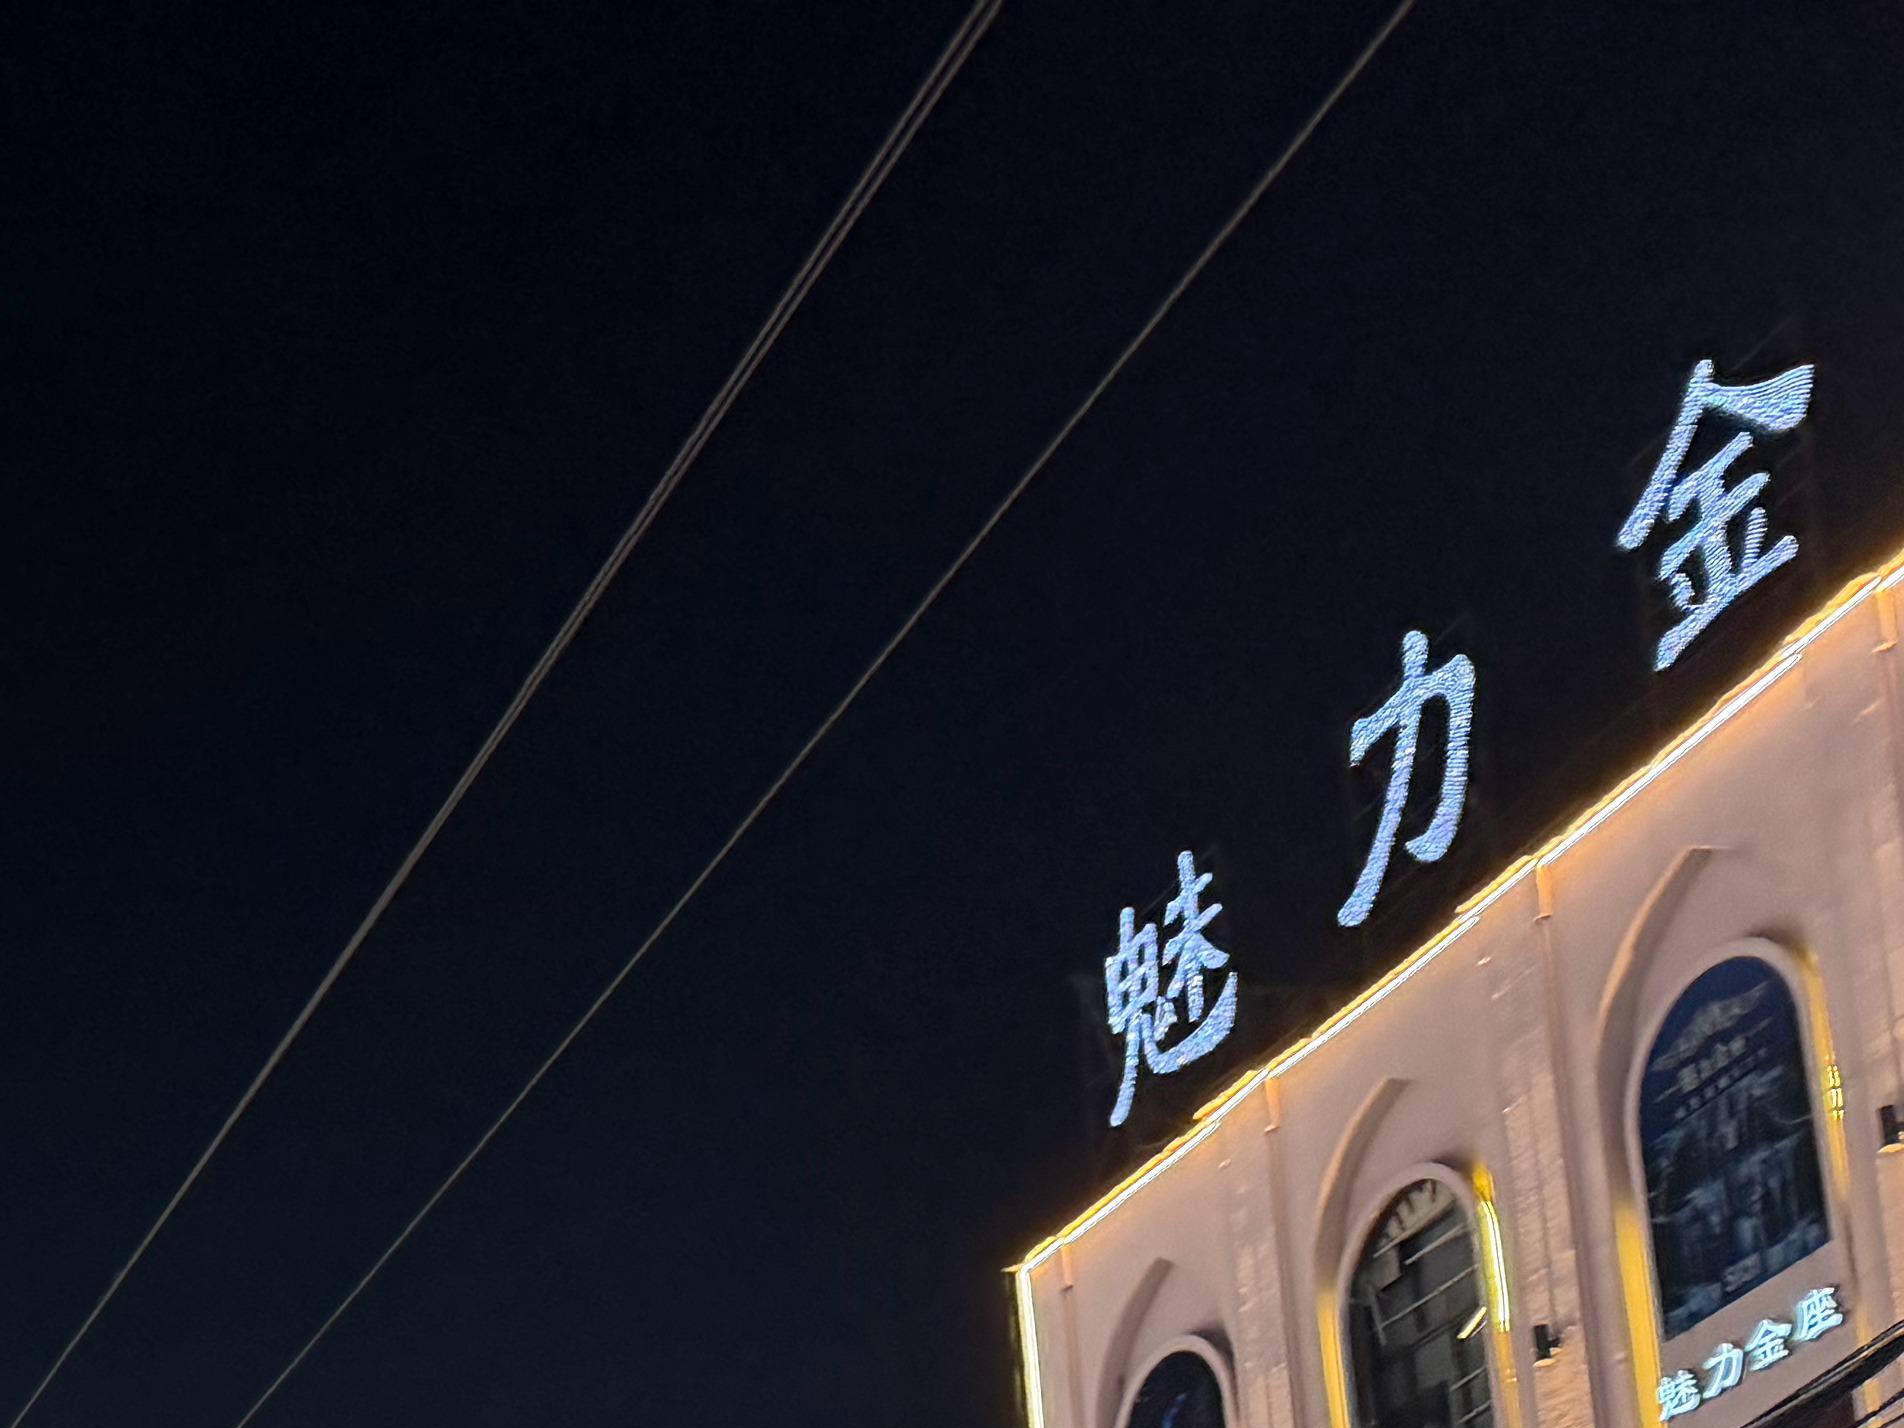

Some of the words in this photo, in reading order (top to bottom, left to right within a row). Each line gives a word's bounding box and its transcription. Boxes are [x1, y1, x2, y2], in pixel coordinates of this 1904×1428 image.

[1106, 359, 1814, 1128] 魅力金
[1656, 1287, 1845, 1422] 魅力金座
